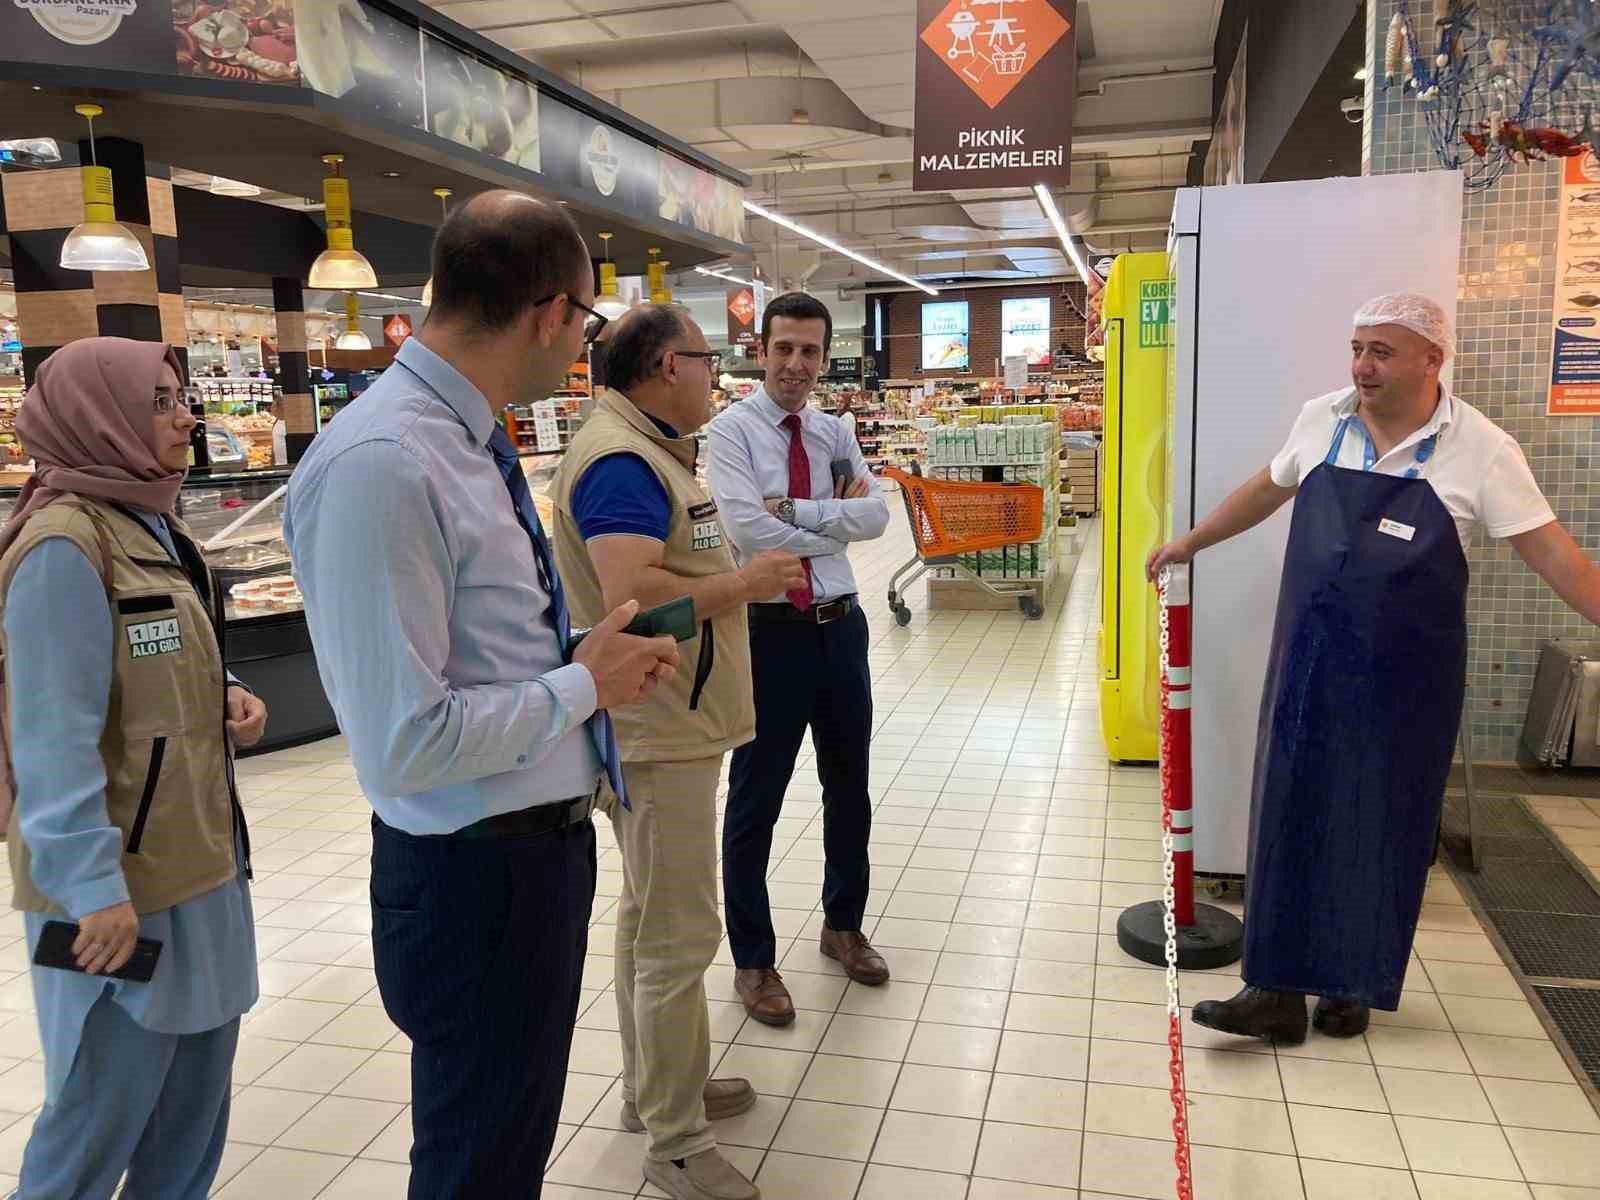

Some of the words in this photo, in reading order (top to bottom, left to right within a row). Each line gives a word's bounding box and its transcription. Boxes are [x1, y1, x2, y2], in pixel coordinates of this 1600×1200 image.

[958, 125, 1025, 148] PİKNİK
[920, 145, 1063, 171] MALZEMELERİ
[1142, 301, 1160, 321] EV
[133, 642, 157, 658] ALO
[159, 637, 181, 653] GIDA
